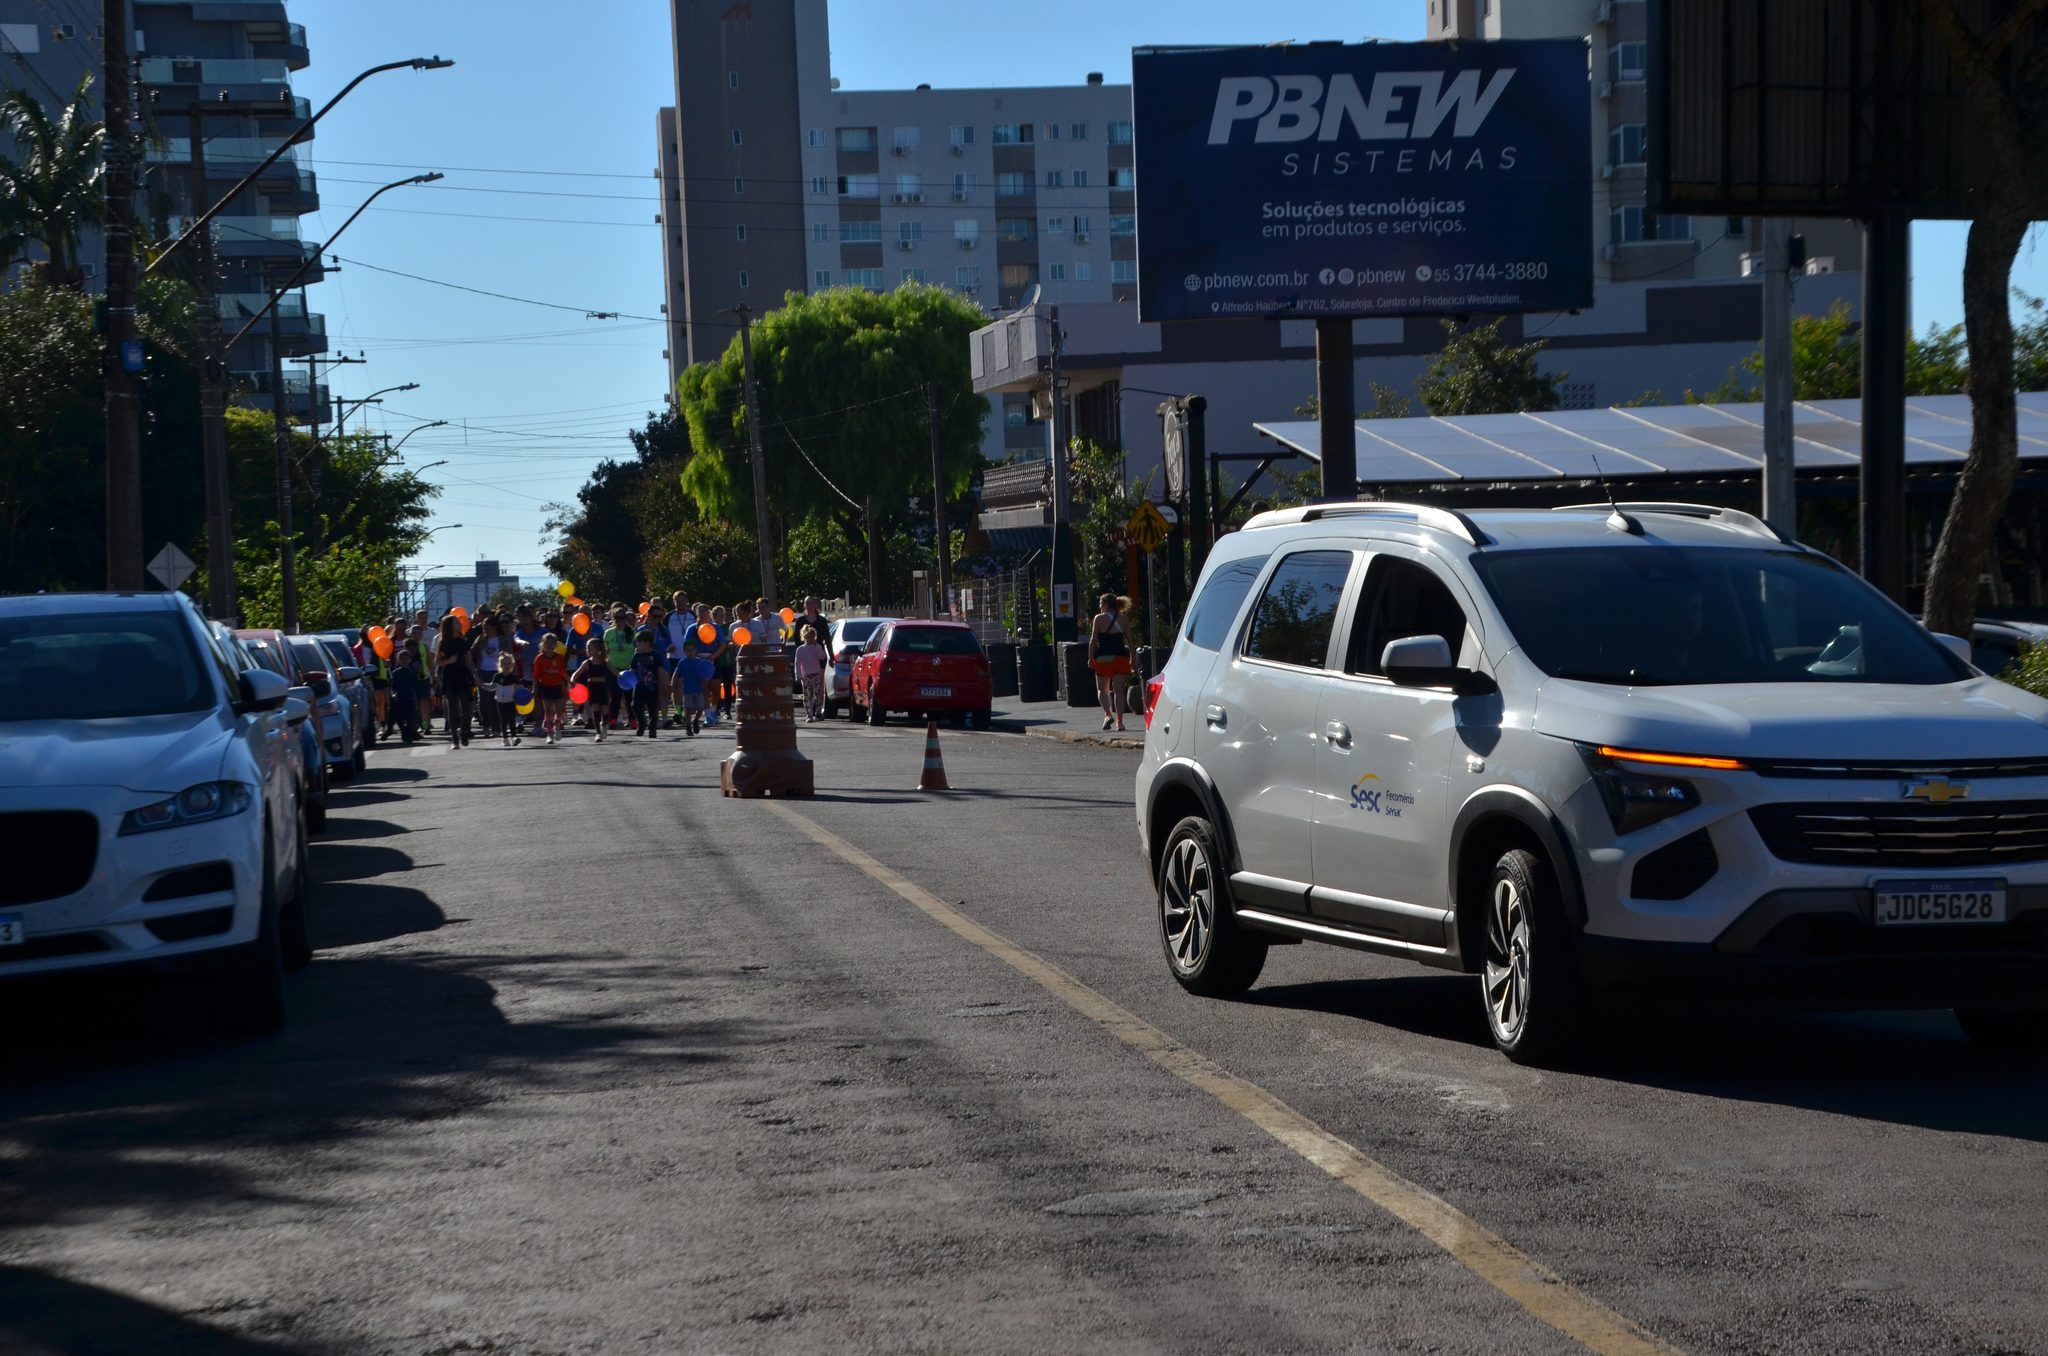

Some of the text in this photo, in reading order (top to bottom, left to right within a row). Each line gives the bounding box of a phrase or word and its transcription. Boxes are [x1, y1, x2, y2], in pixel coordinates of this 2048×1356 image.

[1207, 68, 1518, 145] PBNEW
[1281, 146, 1518, 177] SISTEMAS
[1262, 197, 1466, 221] Soluções tecnológicas
[1262, 217, 1467, 240] em produtos e serviços.
[1204, 270, 1310, 291] pbnew.com.br
[1357, 267, 1406, 287] pbnew
[1434, 261, 1548, 282] 55 3744-3880
[1222, 300, 1254, 313] Alfredo
[1377, 296, 1407, 308] Centro
[1409, 295, 1421, 306] de
[1887, 893, 1993, 920] JDC5G28
